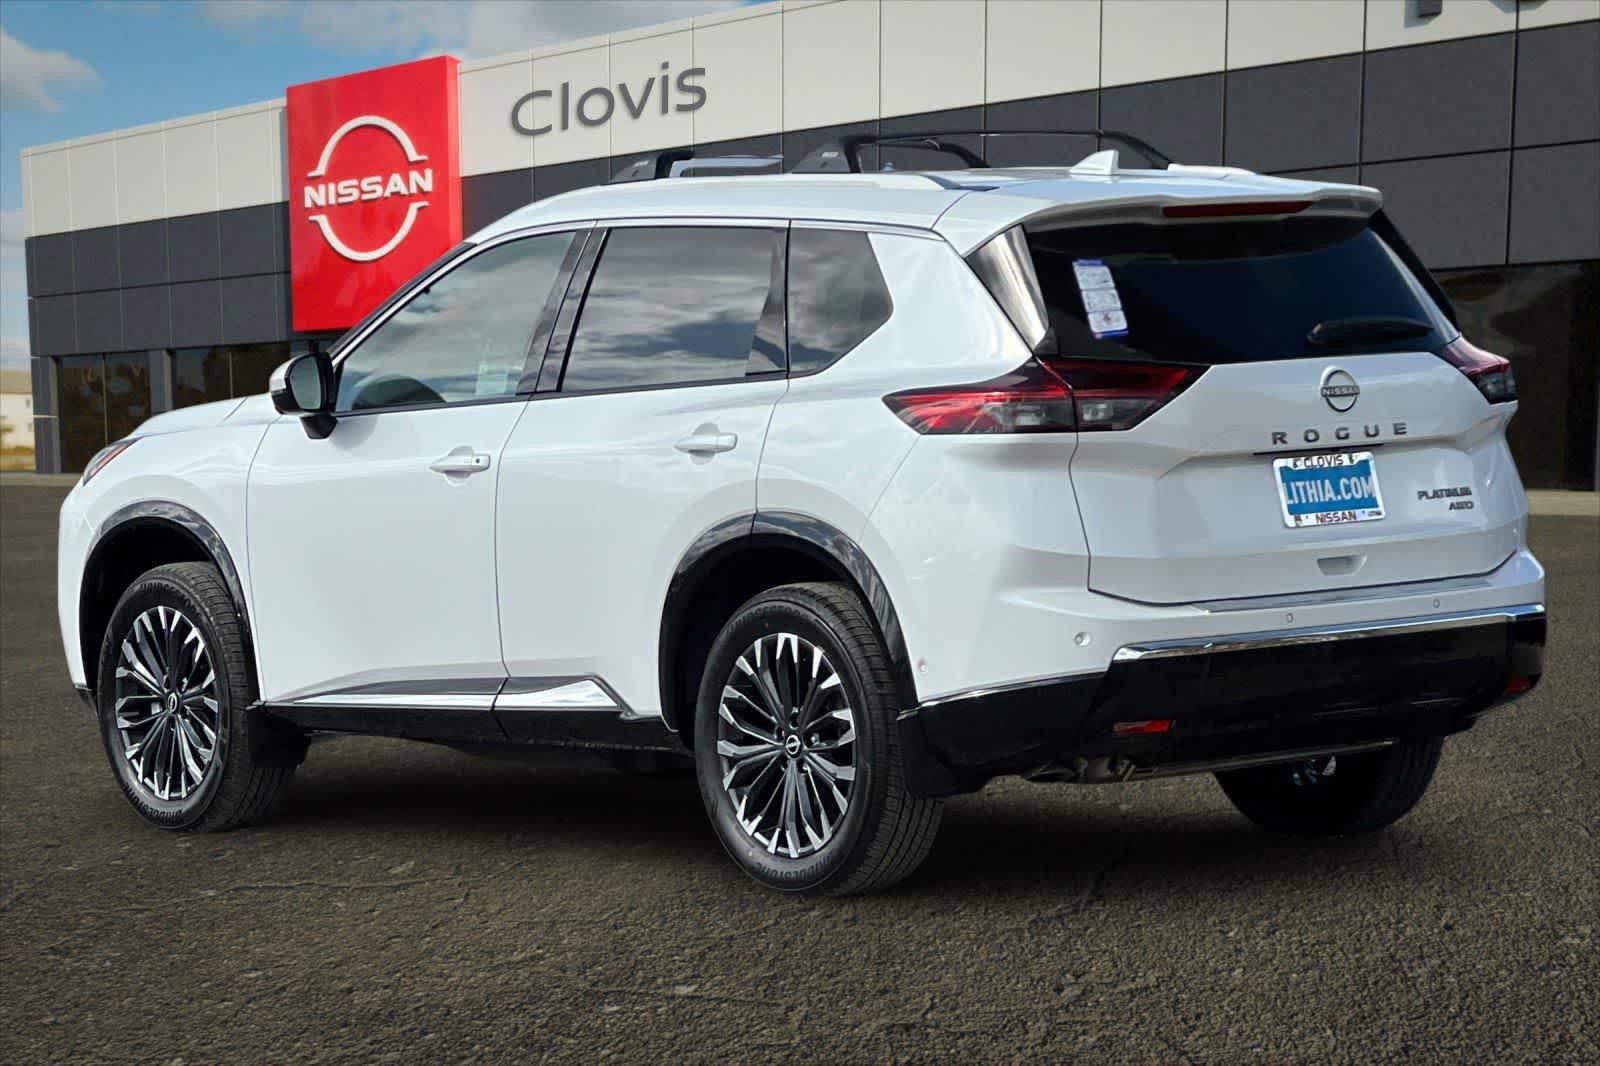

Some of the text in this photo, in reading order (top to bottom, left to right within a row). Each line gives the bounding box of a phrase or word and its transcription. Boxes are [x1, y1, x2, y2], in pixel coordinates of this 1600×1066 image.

[511, 62, 707, 136] Clovis
[304, 168, 433, 208] NISSAN
[1272, 422, 1408, 445] ROGUE
[1303, 455, 1344, 469] CLOVIS
[1283, 476, 1377, 505] LITHIA.COM
[1315, 510, 1357, 523] NISSAN
